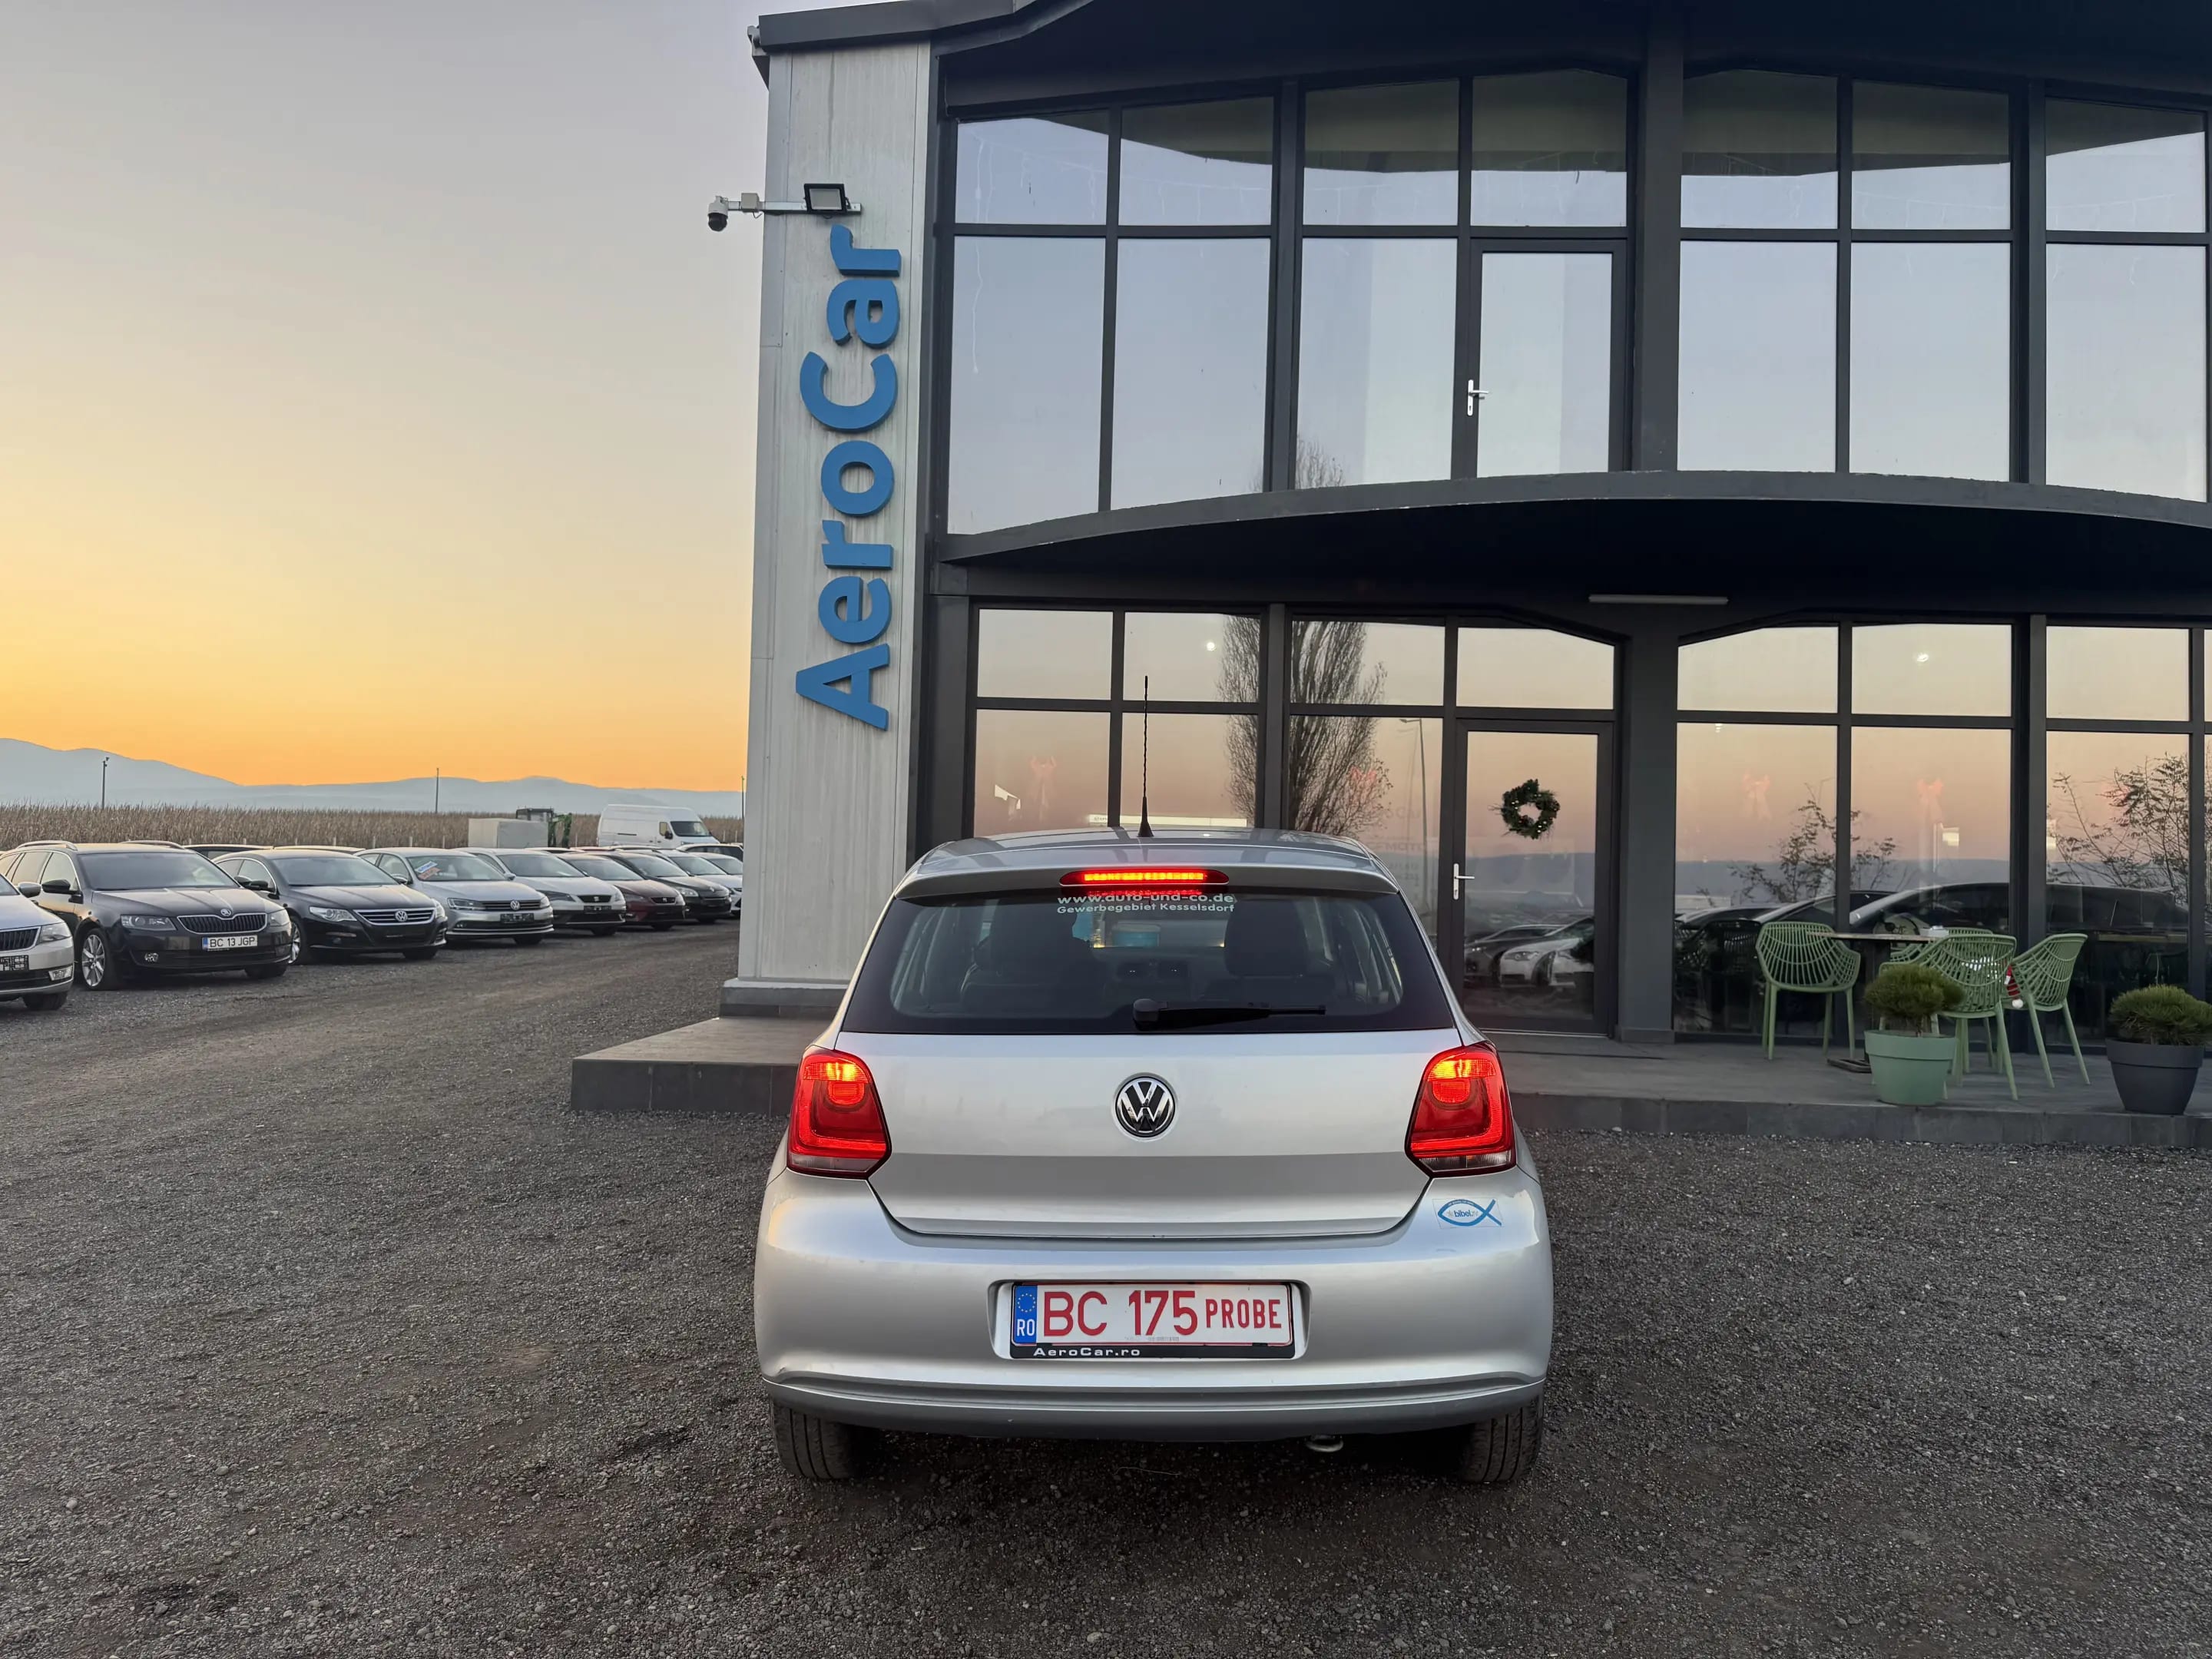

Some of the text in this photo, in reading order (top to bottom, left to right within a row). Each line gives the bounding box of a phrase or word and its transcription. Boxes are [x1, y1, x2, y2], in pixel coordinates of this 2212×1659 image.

[796, 224, 902, 730] AeroCar
[1057, 893, 1234, 905] www.auto-und-co.de
[1057, 902, 1235, 914] Gewerbegebiet Kesselsdorf
[210, 936, 255, 948] BC 13 JGP
[1044, 1290, 1282, 1336] BC 175 PROBE
[1017, 1319, 1035, 1337] RO
[1033, 1347, 1141, 1356] AeroCar.ro
